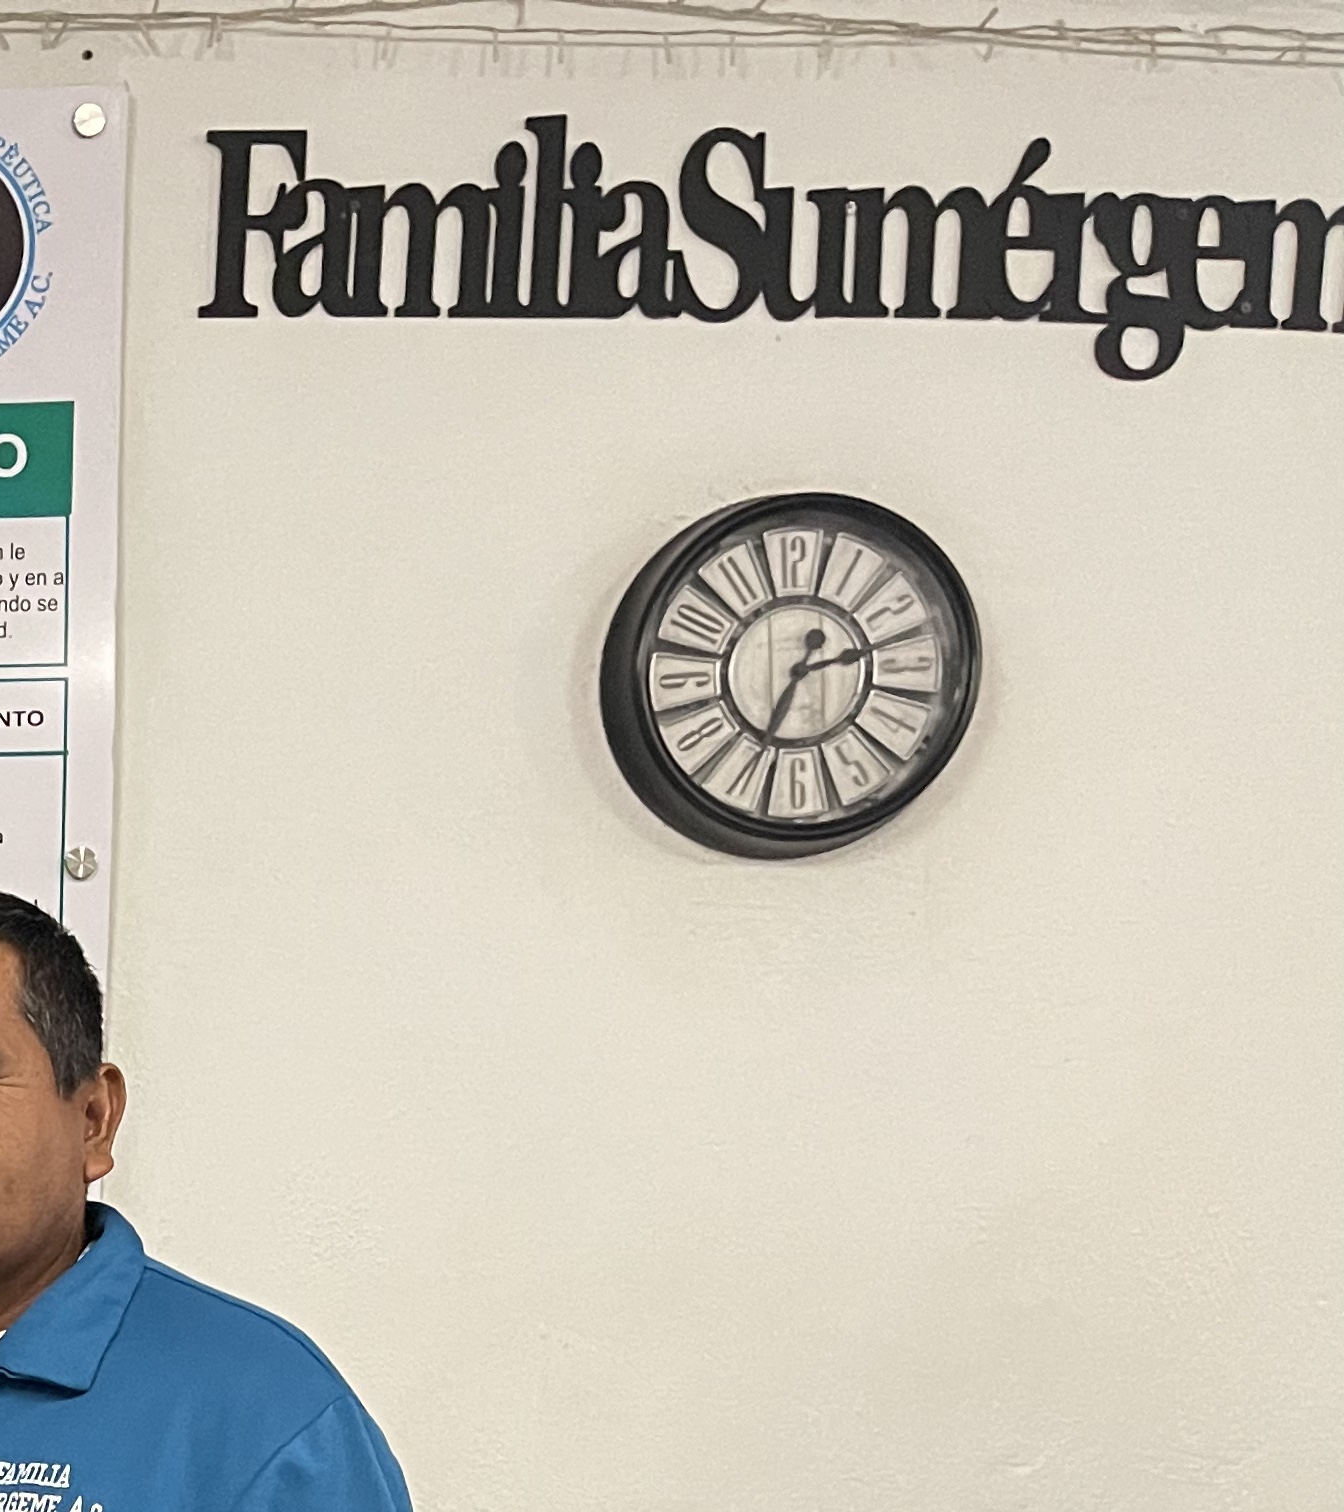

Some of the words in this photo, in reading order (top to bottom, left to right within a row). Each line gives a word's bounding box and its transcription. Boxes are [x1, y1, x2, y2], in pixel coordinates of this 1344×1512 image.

[11, 543, 25, 560] le
[10, 573, 19, 591] y
[25, 573, 46, 585] en
[54, 572, 63, 585] a
[38, 598, 57, 611] se
